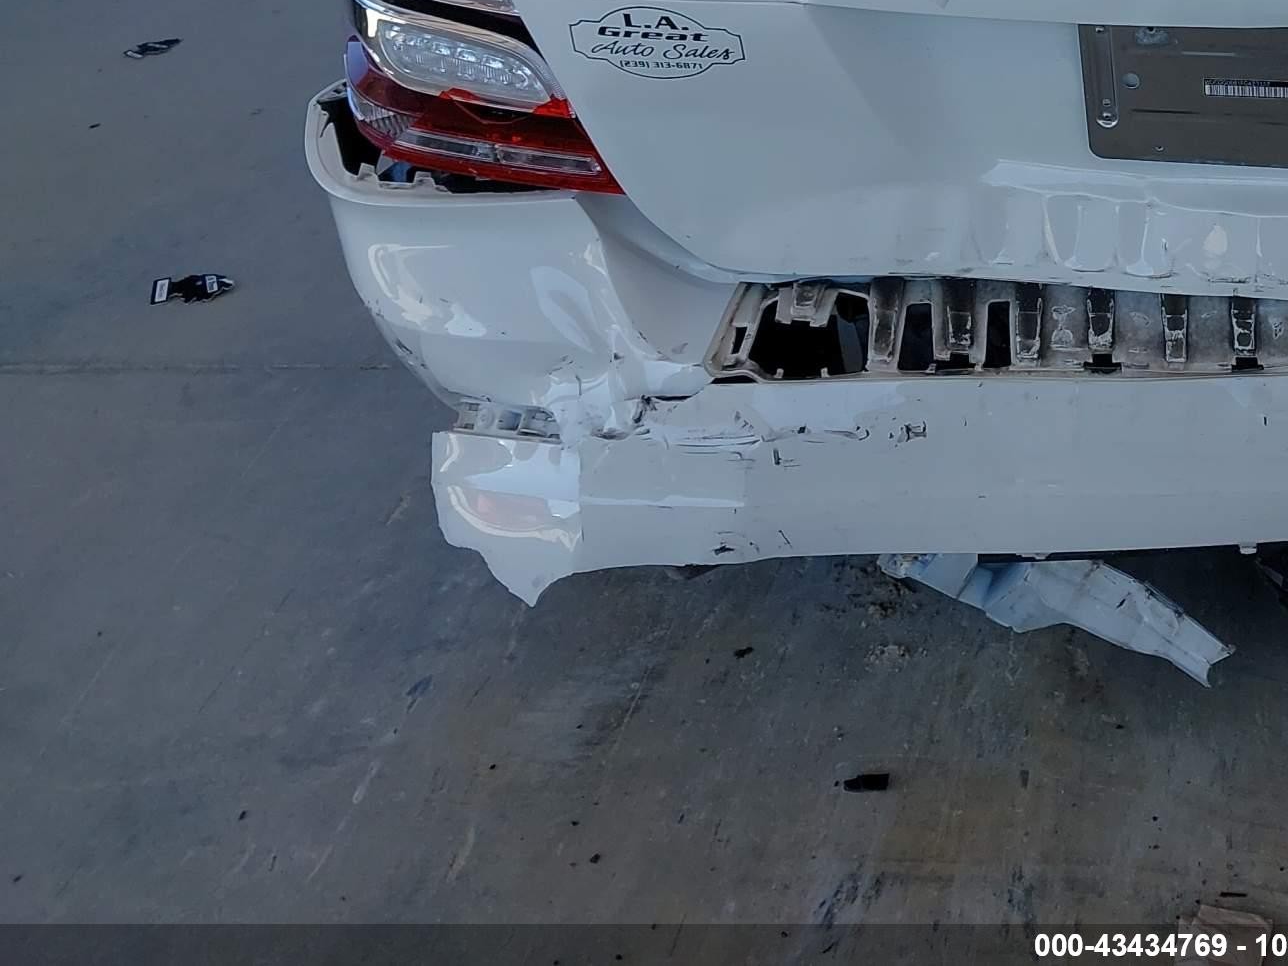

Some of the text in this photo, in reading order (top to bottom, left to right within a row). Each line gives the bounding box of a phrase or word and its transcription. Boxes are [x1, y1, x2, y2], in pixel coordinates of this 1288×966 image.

[623, 13, 689, 31] L.A.
[597, 26, 709, 42] Great
[591, 40, 735, 61] Auto Sales
[619, 59, 650, 69] (239)
